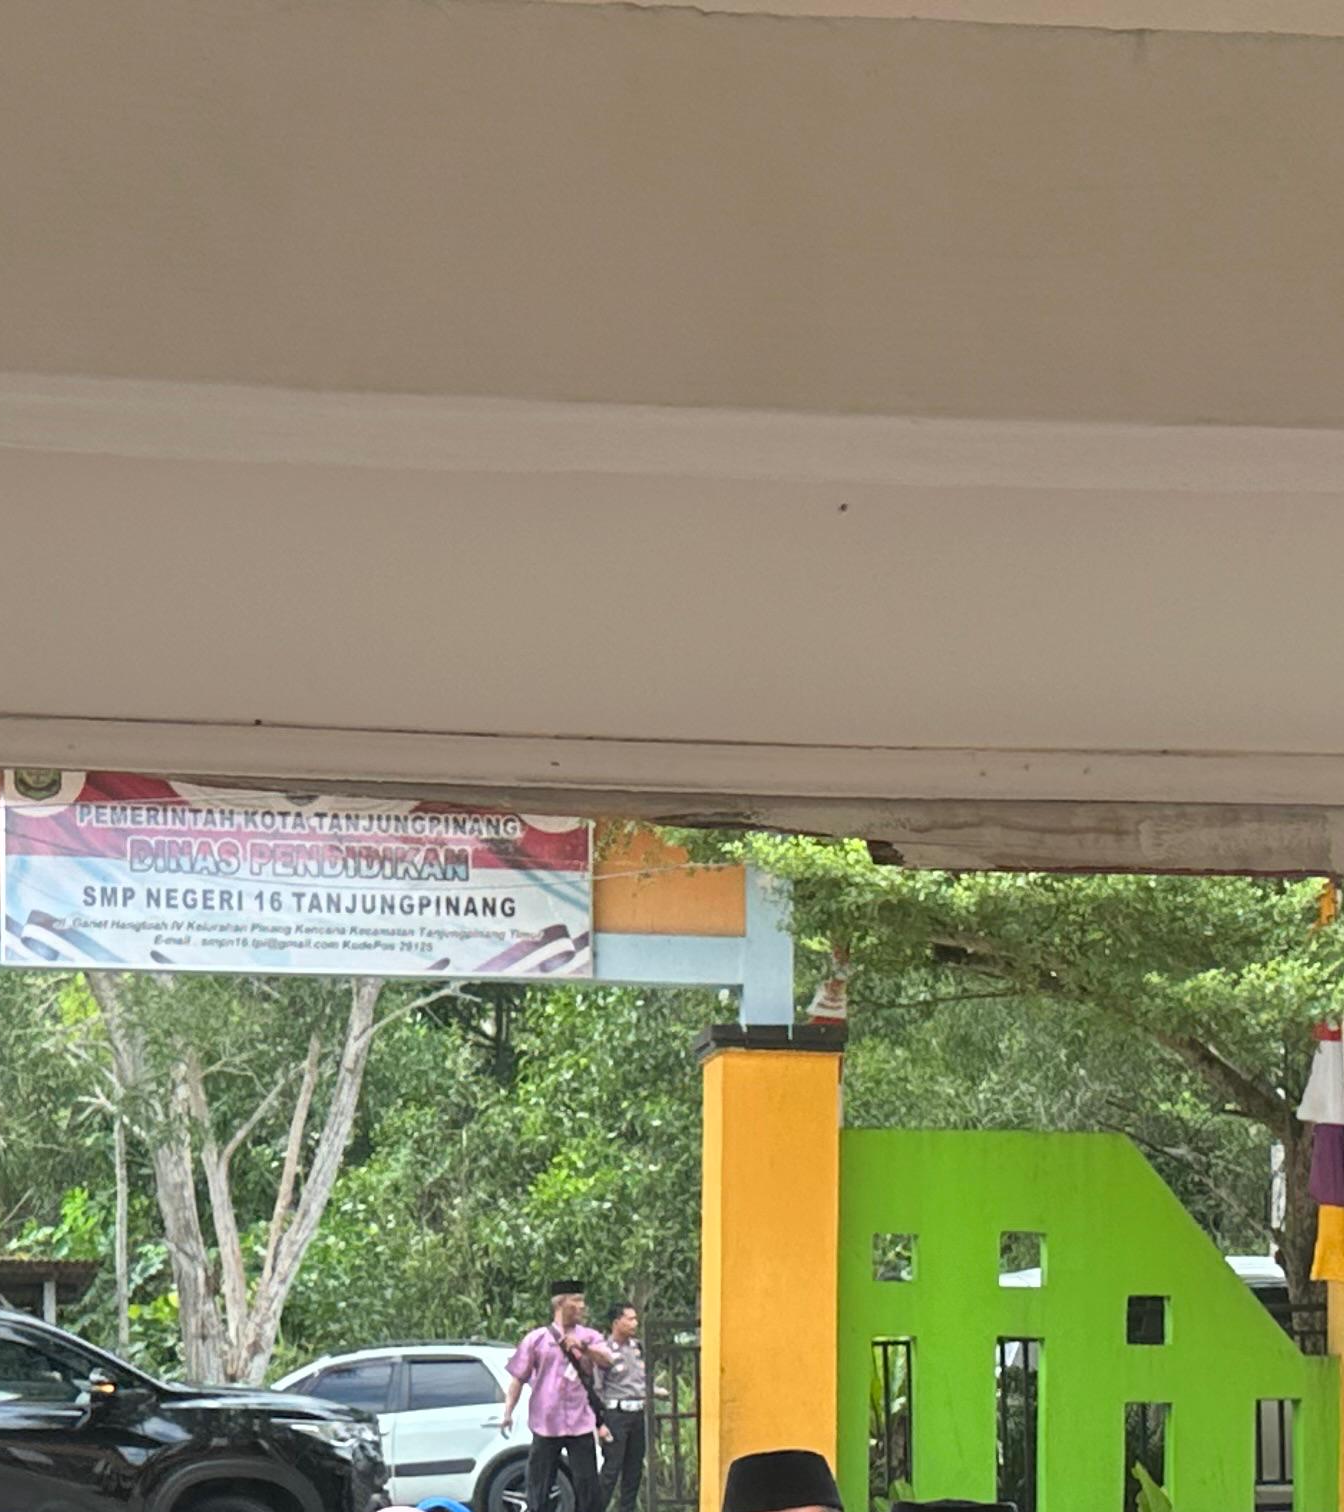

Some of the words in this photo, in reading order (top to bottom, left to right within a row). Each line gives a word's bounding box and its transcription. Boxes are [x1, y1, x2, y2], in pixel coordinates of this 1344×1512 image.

[77, 804, 236, 829] PEMERINTAH
[244, 809, 306, 831] KOTA
[314, 812, 520, 837] TANJUNGPINANG
[128, 836, 242, 876] DINAS
[248, 840, 472, 882] PENDIDIKAN
[83, 886, 136, 908] SMP
[146, 888, 243, 911] NEGERI
[254, 890, 283, 912] 16
[292, 891, 516, 917] TANJUNGPINANG
